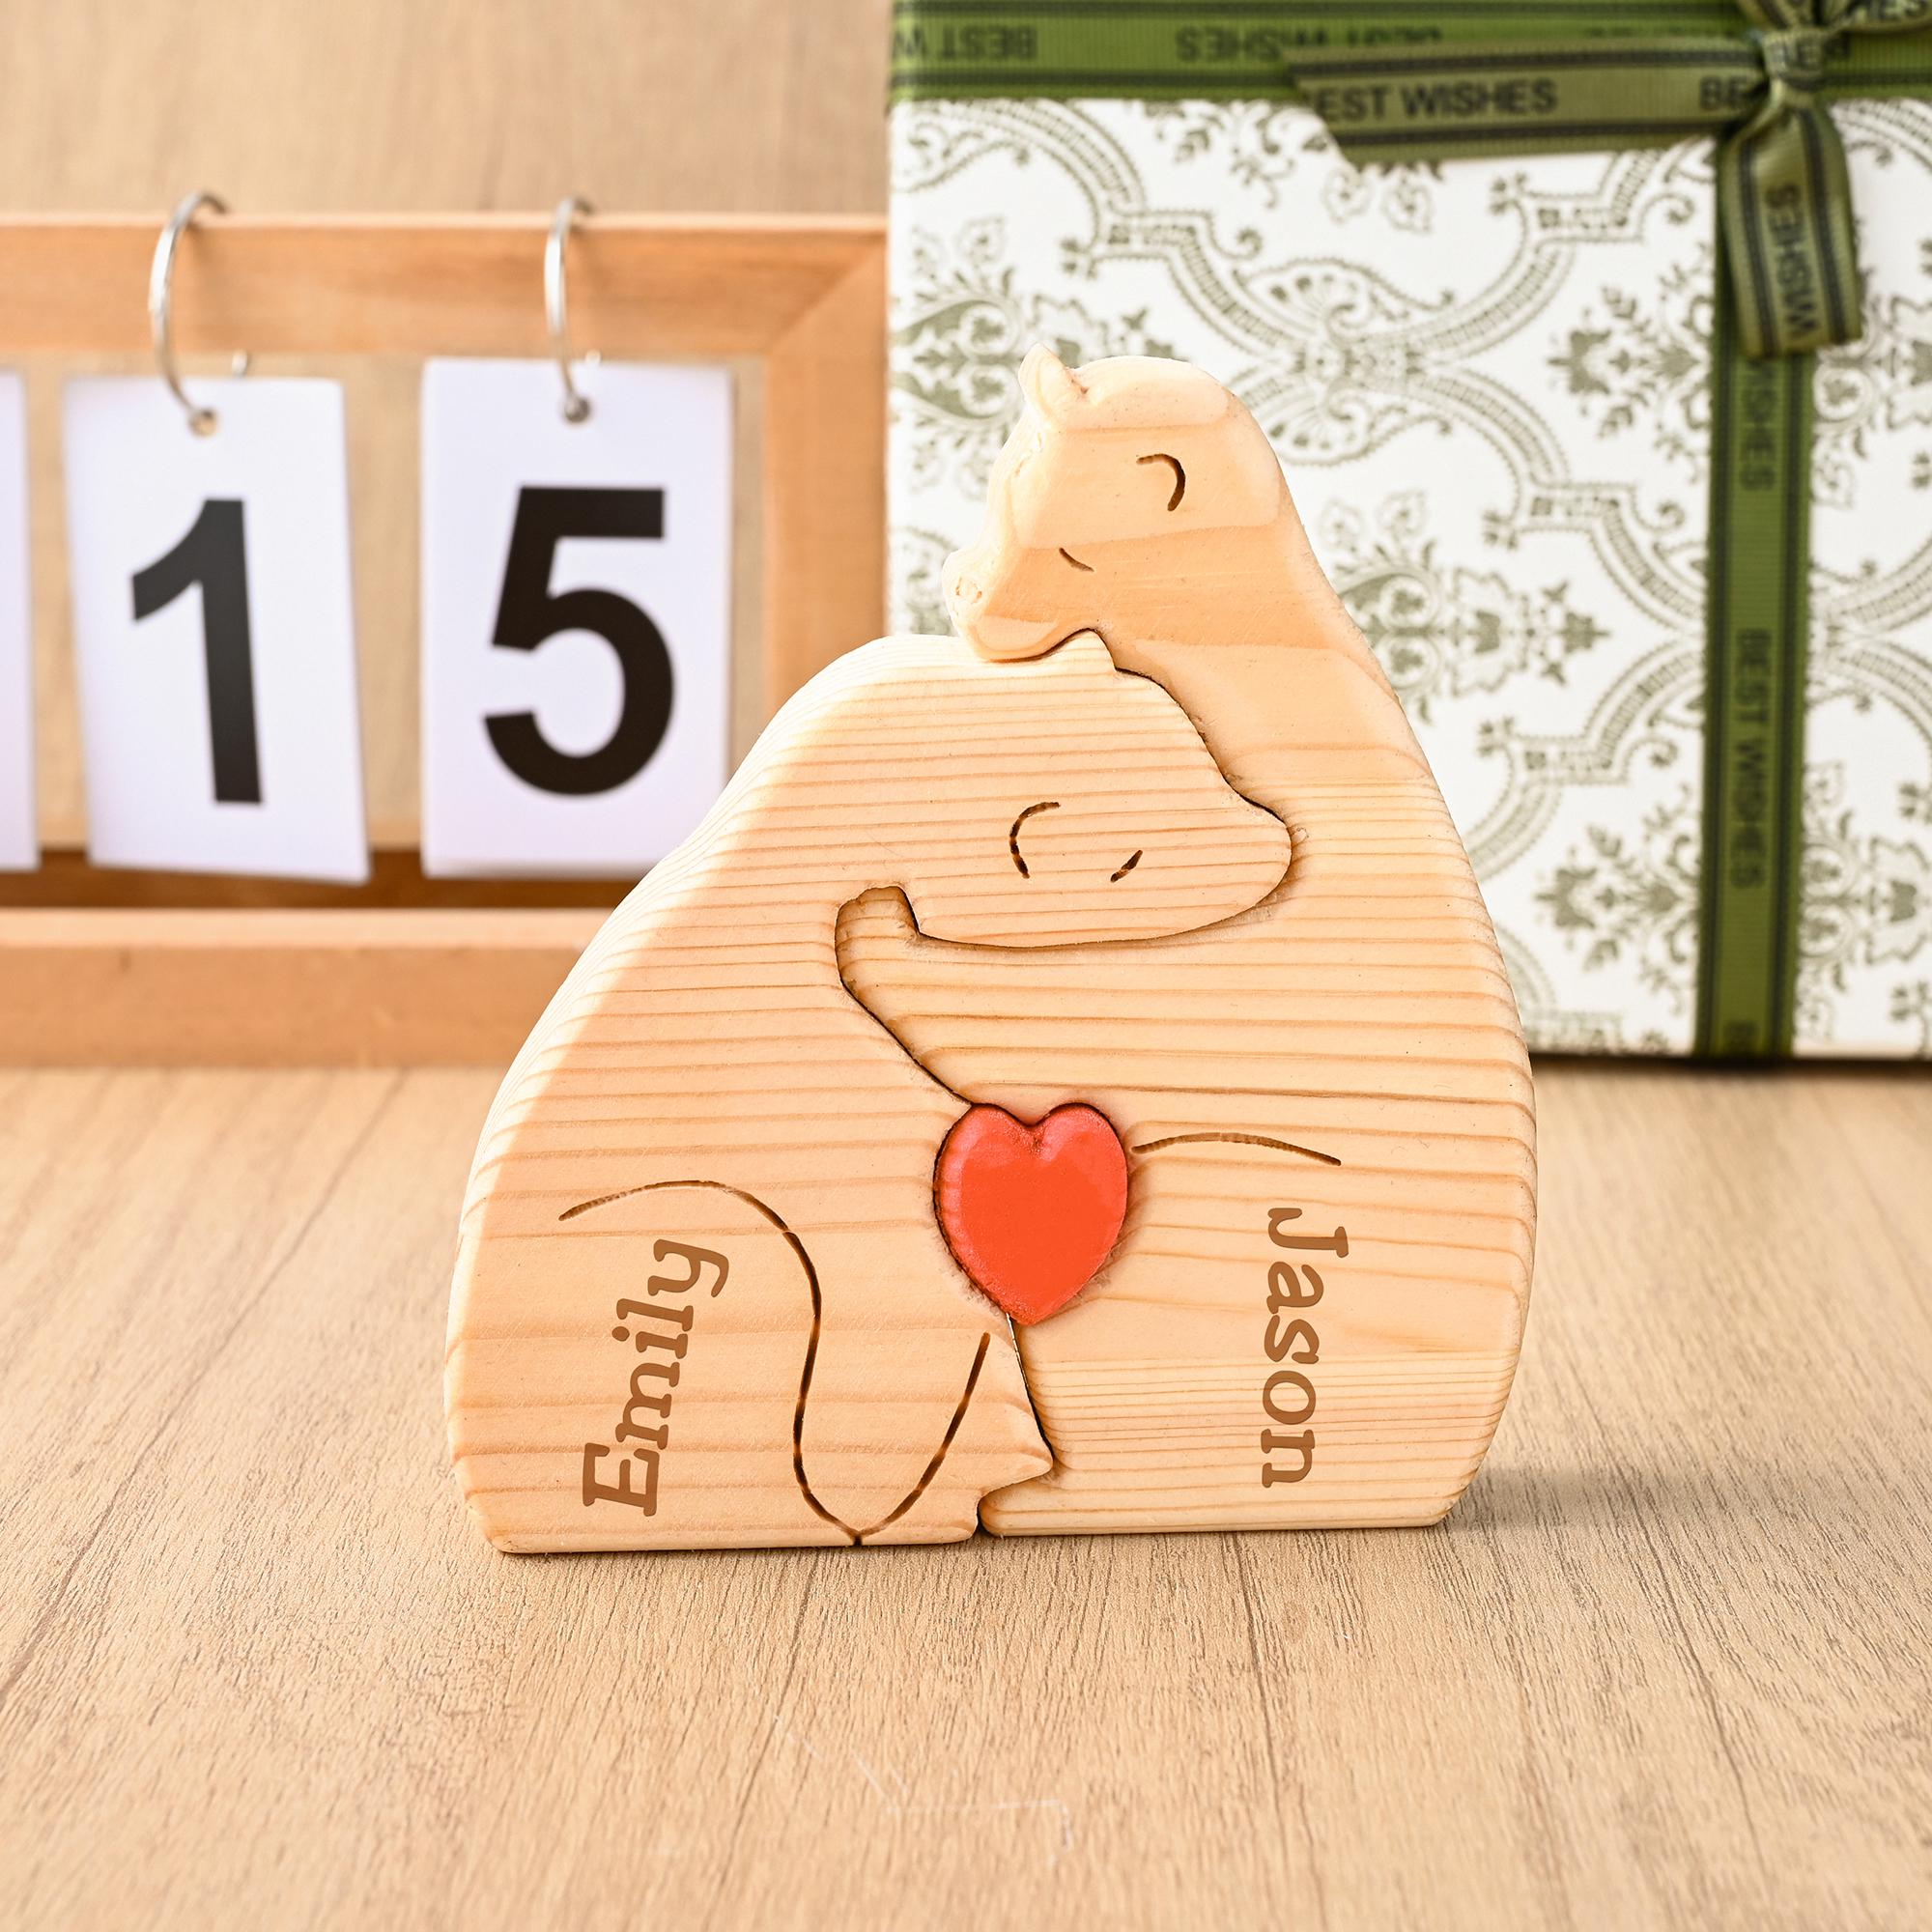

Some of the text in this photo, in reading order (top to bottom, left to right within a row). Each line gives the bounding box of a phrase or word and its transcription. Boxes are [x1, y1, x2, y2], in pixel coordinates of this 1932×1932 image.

[939, 24, 1038, 62] BEST
[1401, 76, 1558, 119] WISHES
[1765, 183, 1821, 338] WISHES
[132, 500, 261, 804] 1
[485, 487, 674, 796] 5
[1729, 630, 1774, 889] BEST WISHES
[582, 1238, 729, 1517] Emily
[1261, 1208, 1349, 1489] Jason
